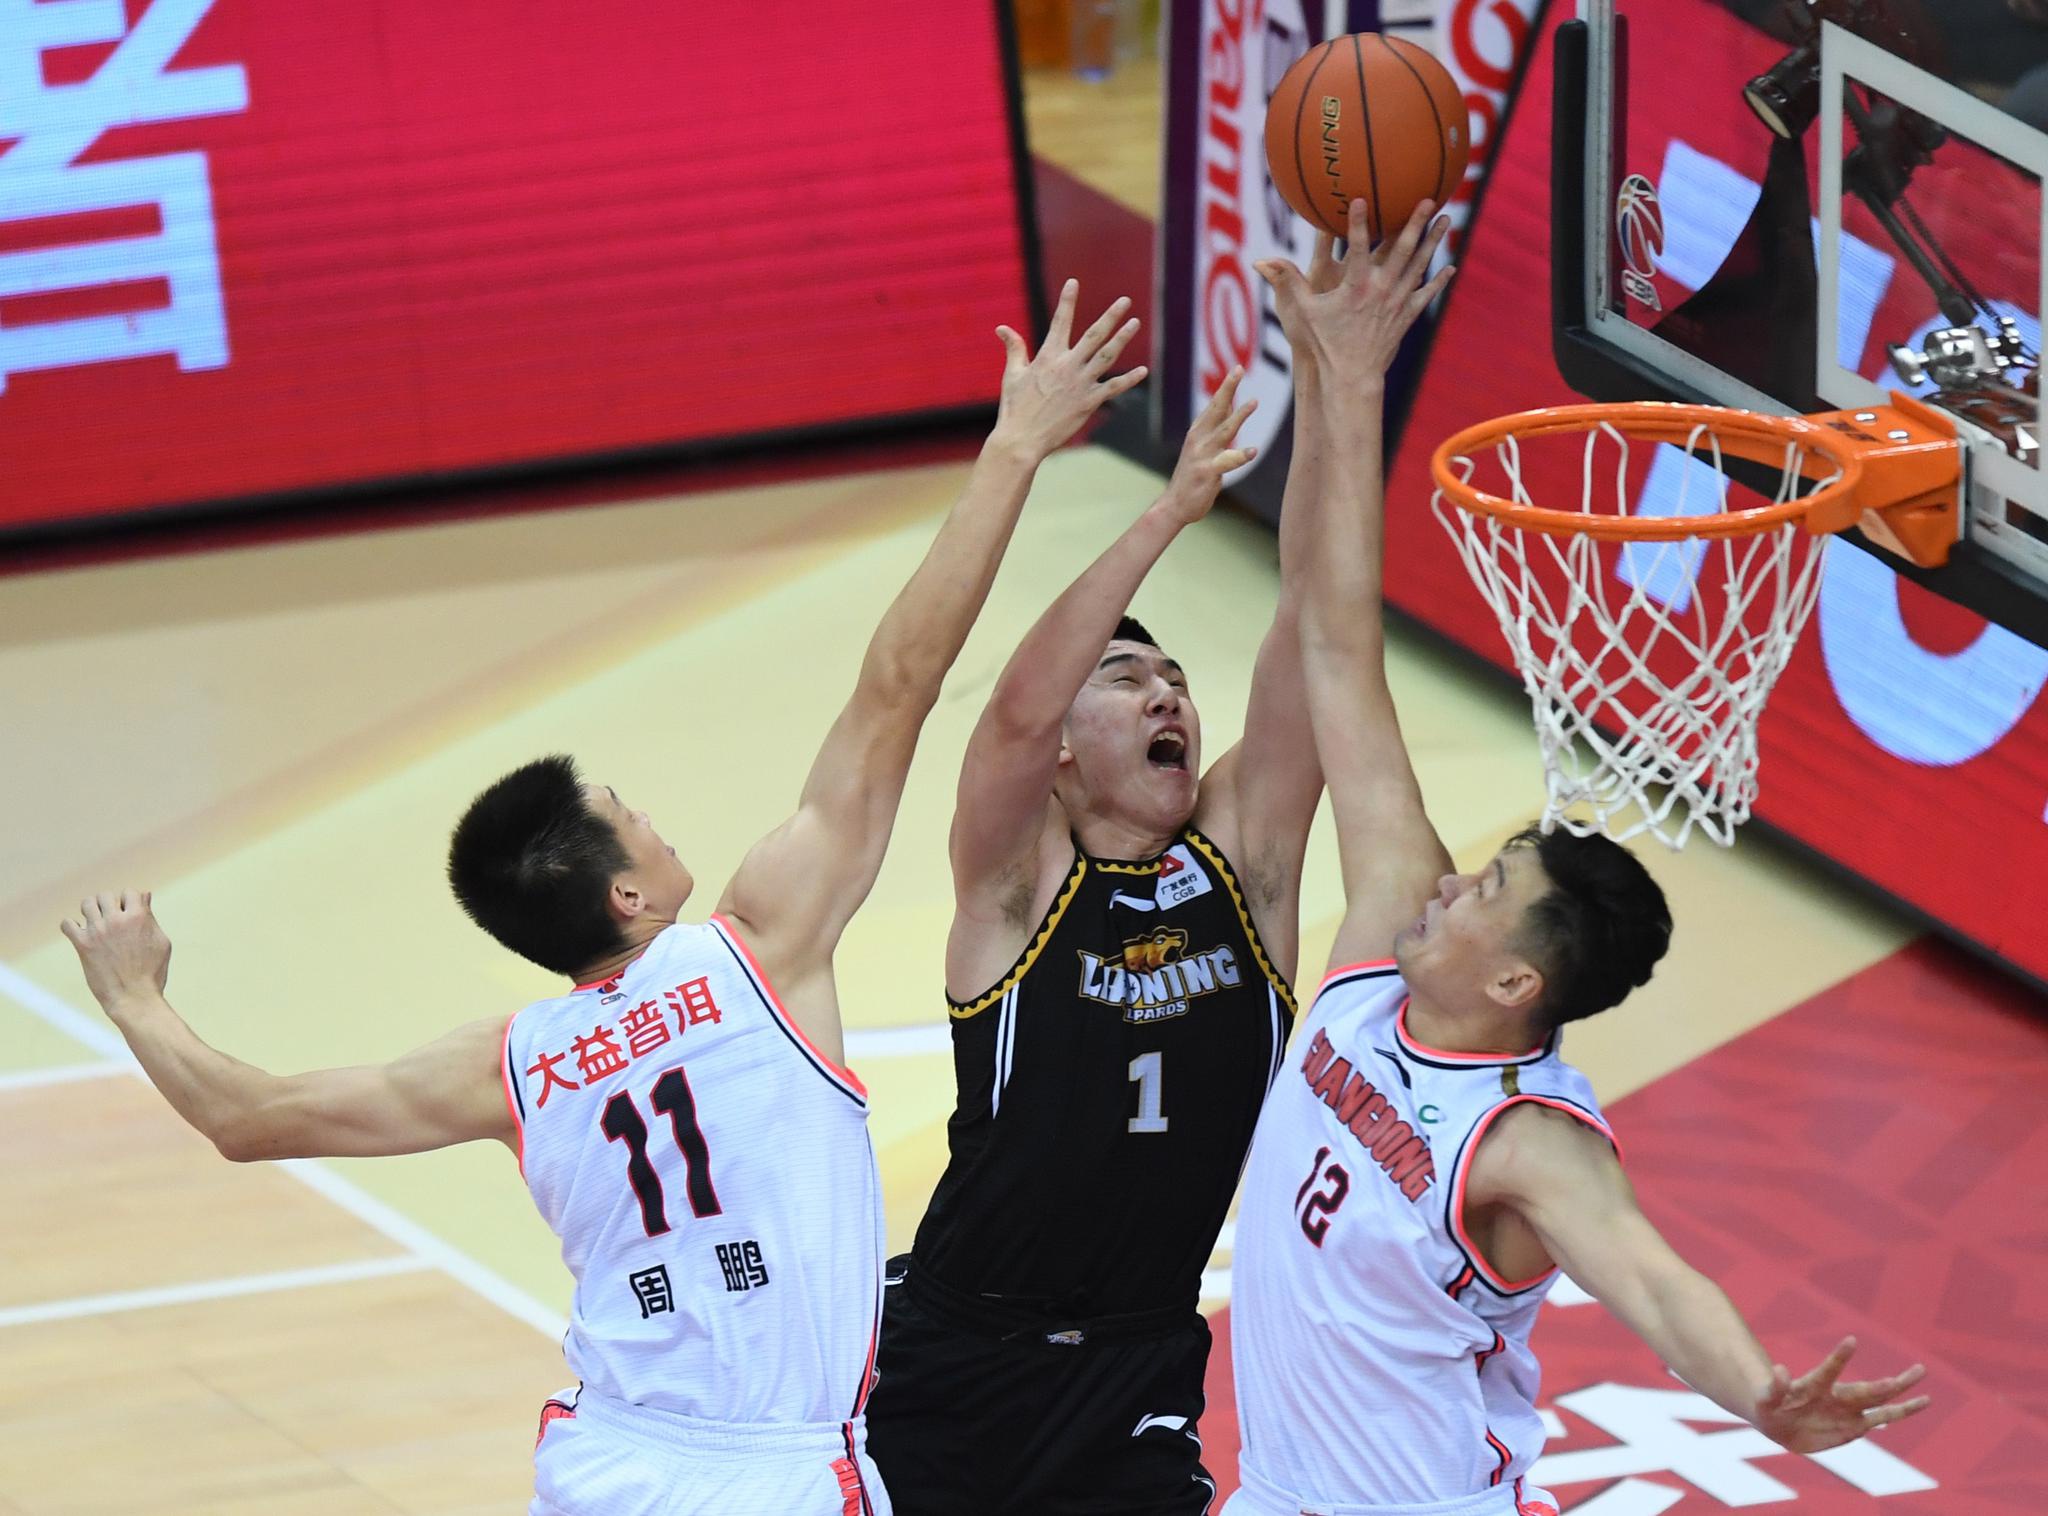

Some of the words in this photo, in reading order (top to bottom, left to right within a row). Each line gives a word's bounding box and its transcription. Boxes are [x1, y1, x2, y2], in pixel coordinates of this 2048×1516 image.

[1172, 886, 1196, 902] CGB
[526, 976, 722, 1110] 大益普洱
[1128, 1051, 1169, 1134] 1
[600, 1066, 723, 1239] 11
[1295, 1146, 1350, 1249] 12
